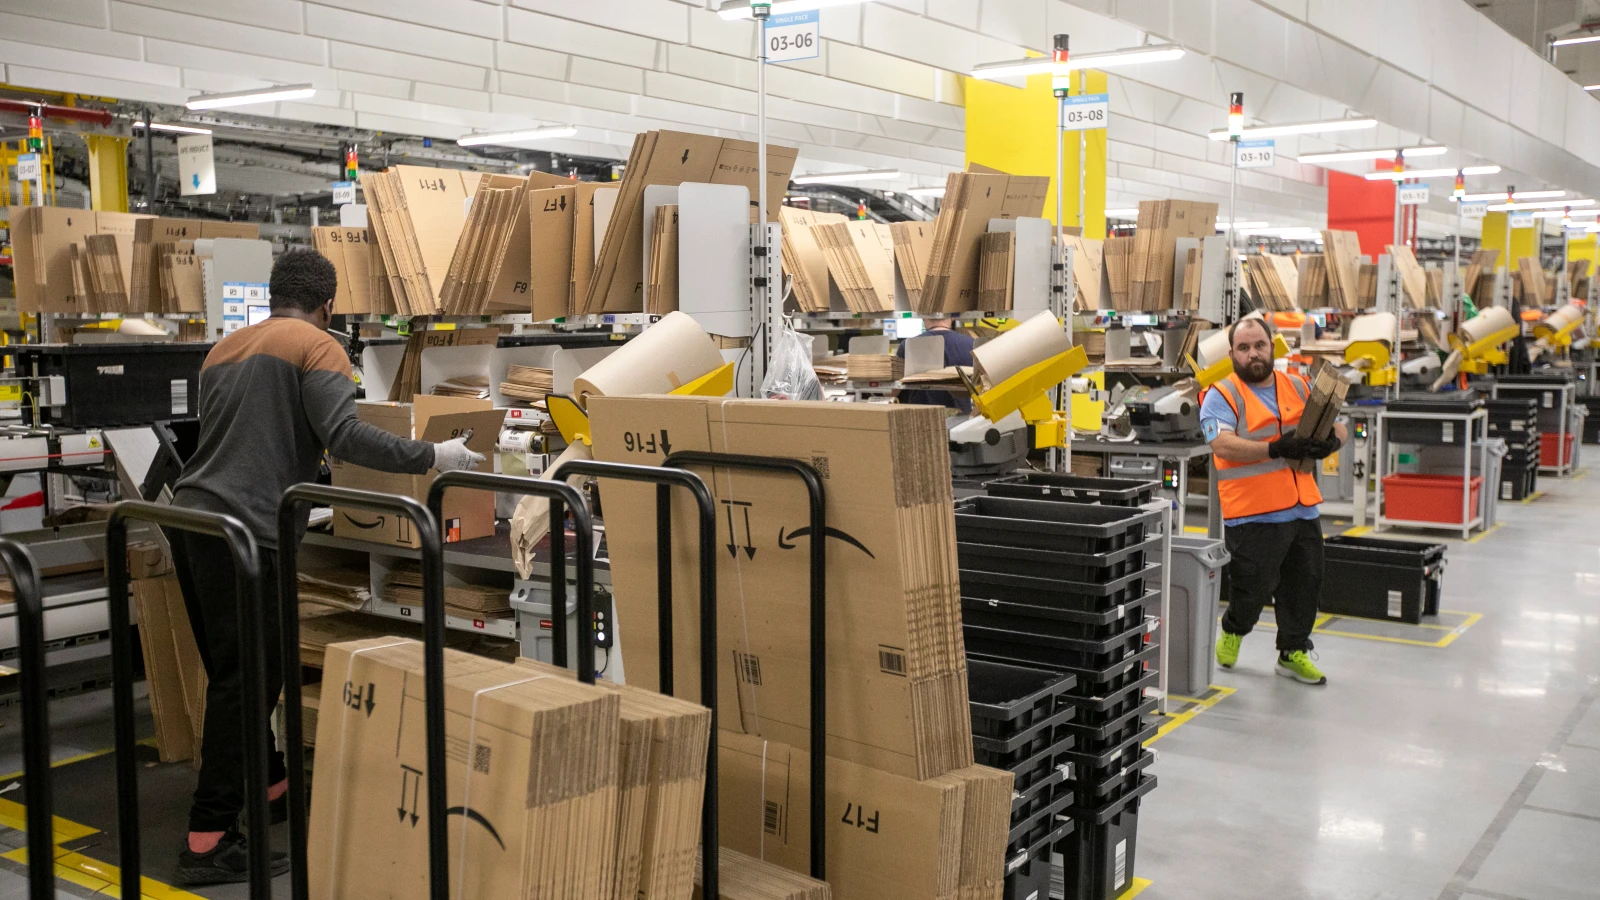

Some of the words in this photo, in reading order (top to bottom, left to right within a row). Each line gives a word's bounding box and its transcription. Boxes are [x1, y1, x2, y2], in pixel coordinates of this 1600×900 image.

[774, 16, 794, 24] SINGLE
[794, 14, 809, 22] PACK
[770, 32, 813, 52] 03-06
[1068, 109, 1104, 123] 03-08
[1240, 152, 1271, 162] 03-10
[19, 165, 35, 175] 03-07
[419, 179, 438, 191] F11
[543, 198, 558, 212] F7
[166, 227, 180, 237] F11
[346, 232, 361, 243] F6
[513, 281, 528, 294] F9
[427, 335, 445, 347] F0a
[624, 431, 657, 454] F16
[342, 680, 364, 711] F9
[841, 802, 880, 833] F17
